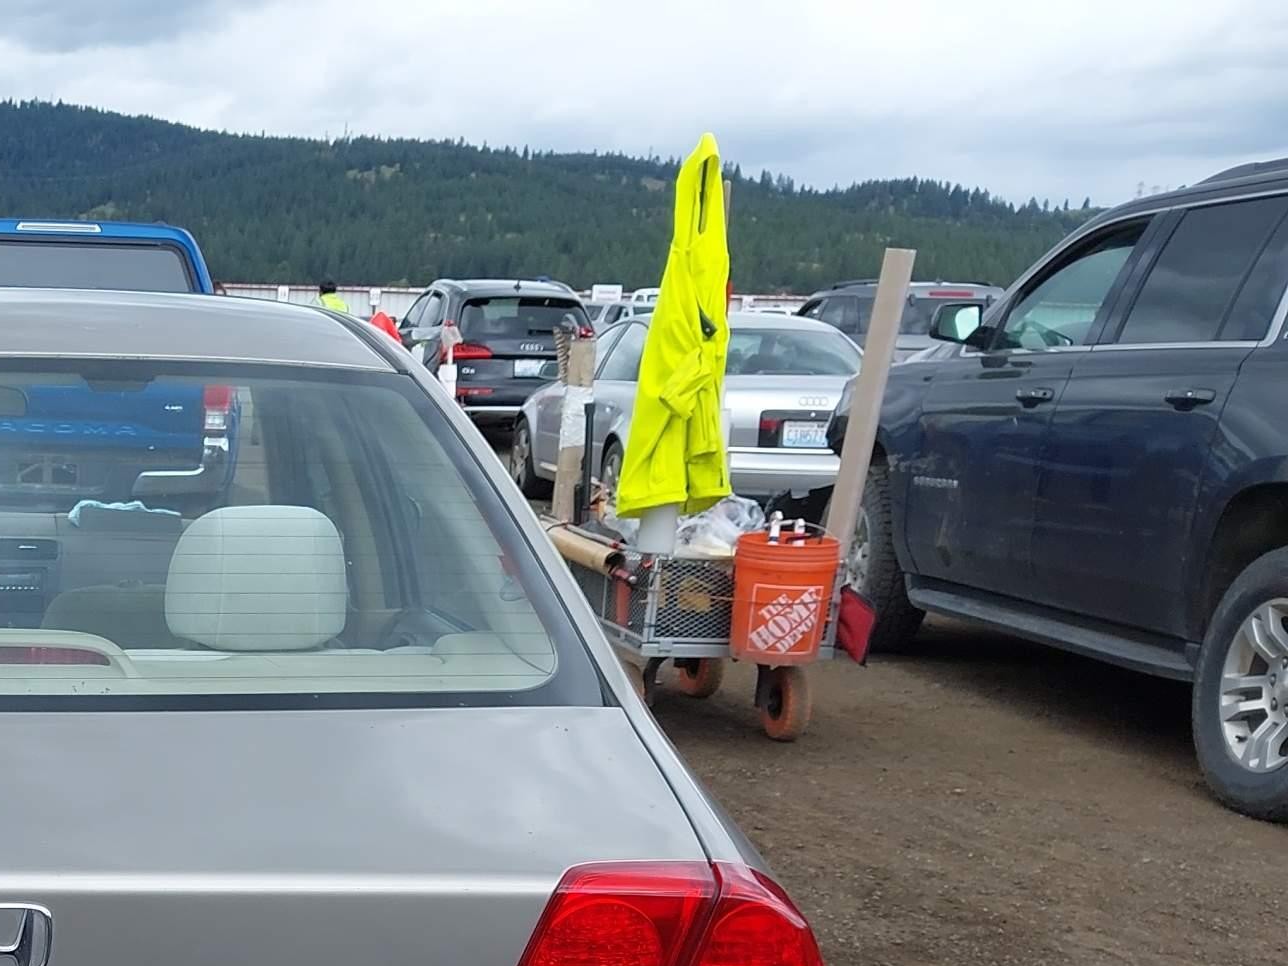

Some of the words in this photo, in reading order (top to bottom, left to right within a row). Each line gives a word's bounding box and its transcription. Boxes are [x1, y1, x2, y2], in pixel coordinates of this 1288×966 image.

[749, 587, 821, 650] HOME
[758, 593, 793, 620] THE
[775, 611, 818, 654] DEPOT
